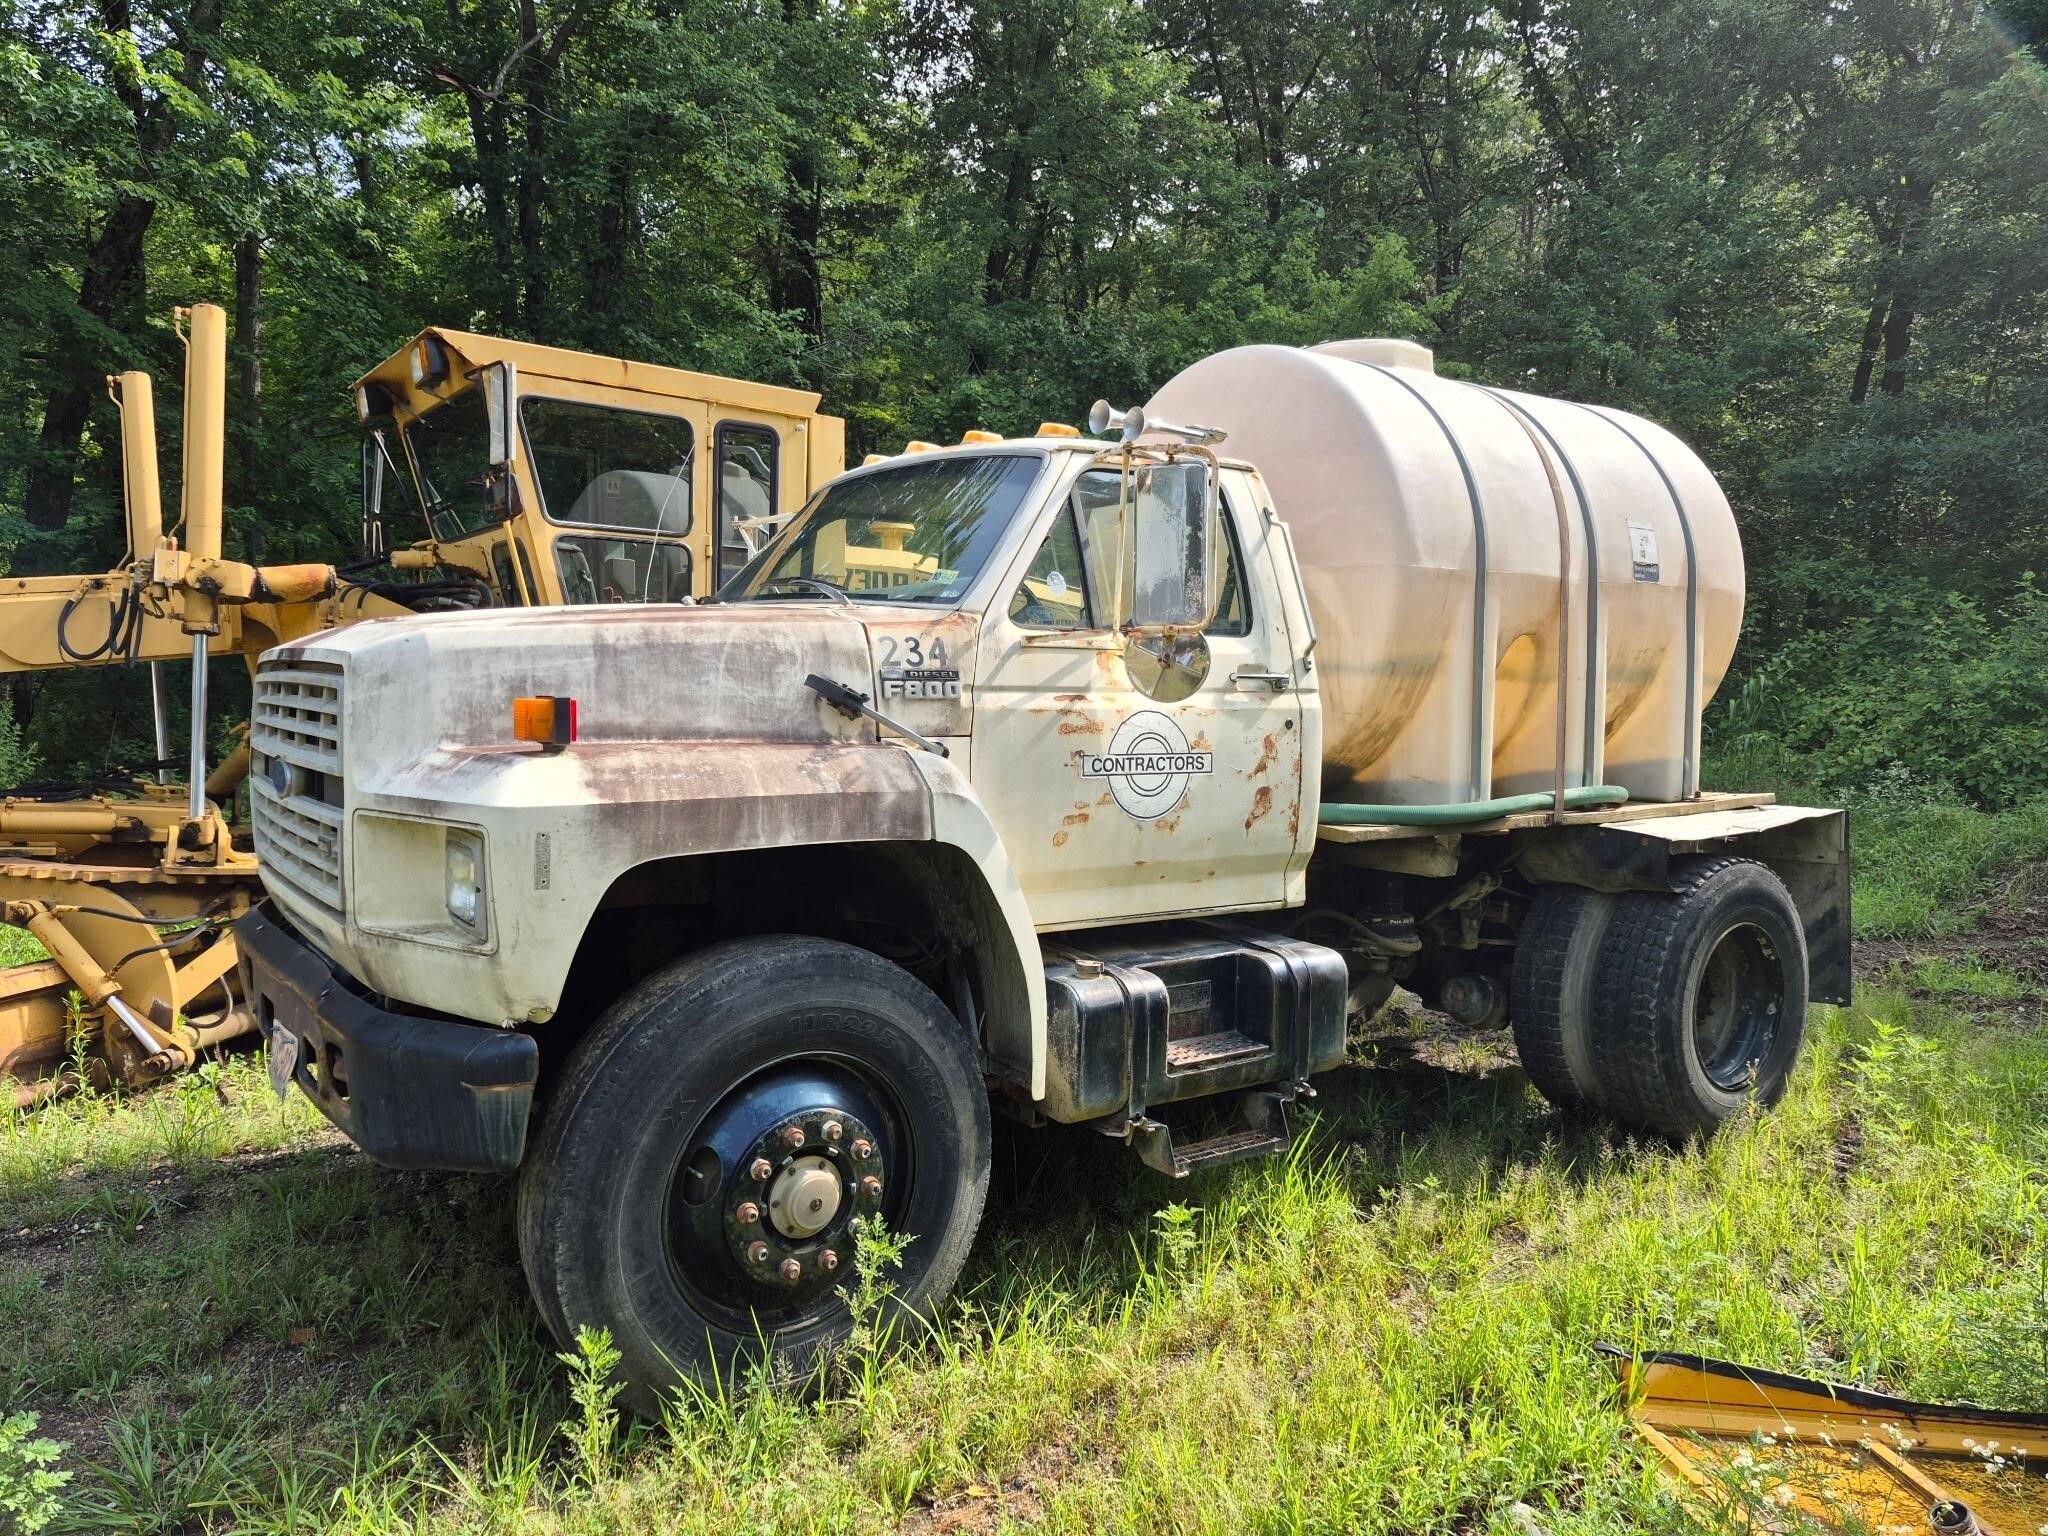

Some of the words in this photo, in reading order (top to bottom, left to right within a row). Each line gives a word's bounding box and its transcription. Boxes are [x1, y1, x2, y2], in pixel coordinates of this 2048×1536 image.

[878, 636, 948, 669] 234
[884, 681, 961, 700] F800
[1091, 756, 1205, 773] CONTRACTORS
